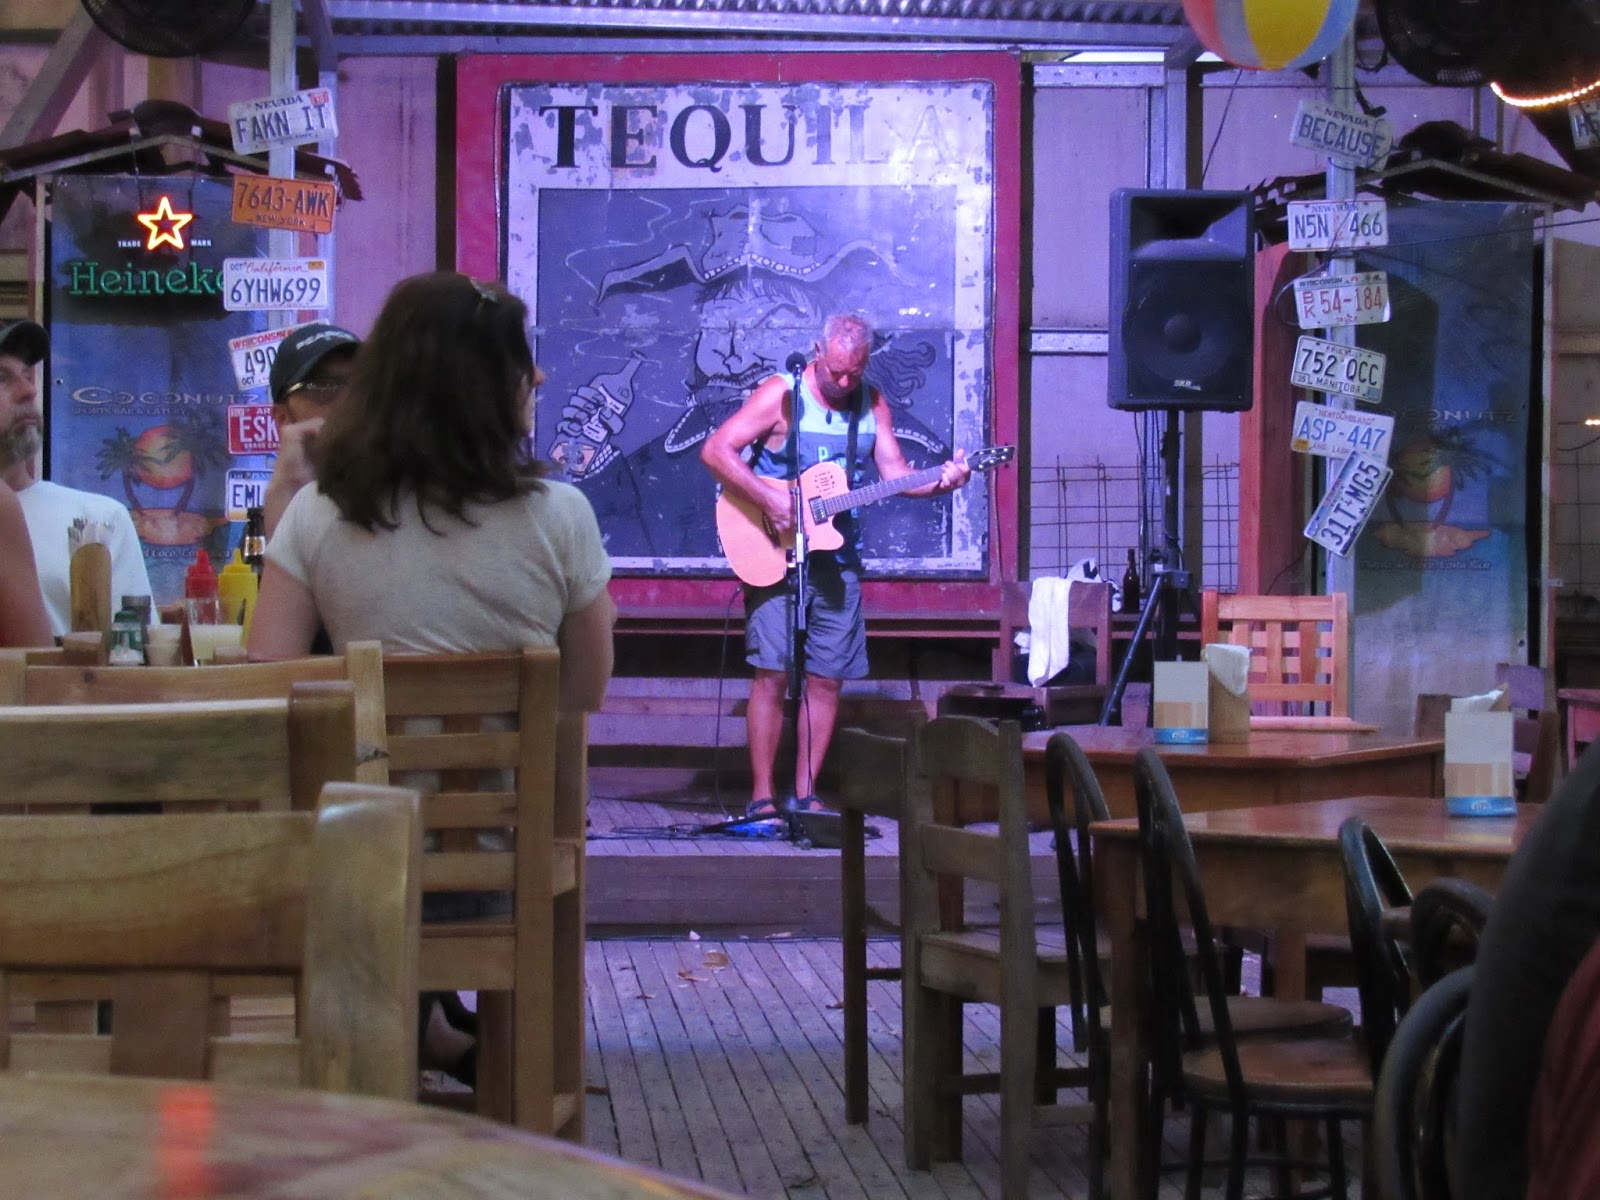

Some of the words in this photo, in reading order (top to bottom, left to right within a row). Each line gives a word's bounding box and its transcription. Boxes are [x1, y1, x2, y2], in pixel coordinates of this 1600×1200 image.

[255, 95, 303, 111] NEVADA
[235, 108, 292, 143] FAKN
[302, 104, 328, 132] IT
[1325, 107, 1369, 128] NEVADA
[538, 104, 962, 174] TEQUILA
[1299, 113, 1386, 160] BECAUSE
[237, 182, 331, 218] 7643-AWK
[1294, 213, 1329, 239] N5N
[1349, 211, 1383, 237] 466
[190, 239, 212, 247] MARK
[230, 277, 322, 303] 6YHW699
[1320, 286, 1382, 315] 54-184
[1300, 348, 1338, 377] 752
[1345, 358, 1379, 386] QCC
[1316, 377, 1360, 394] MANITOBA
